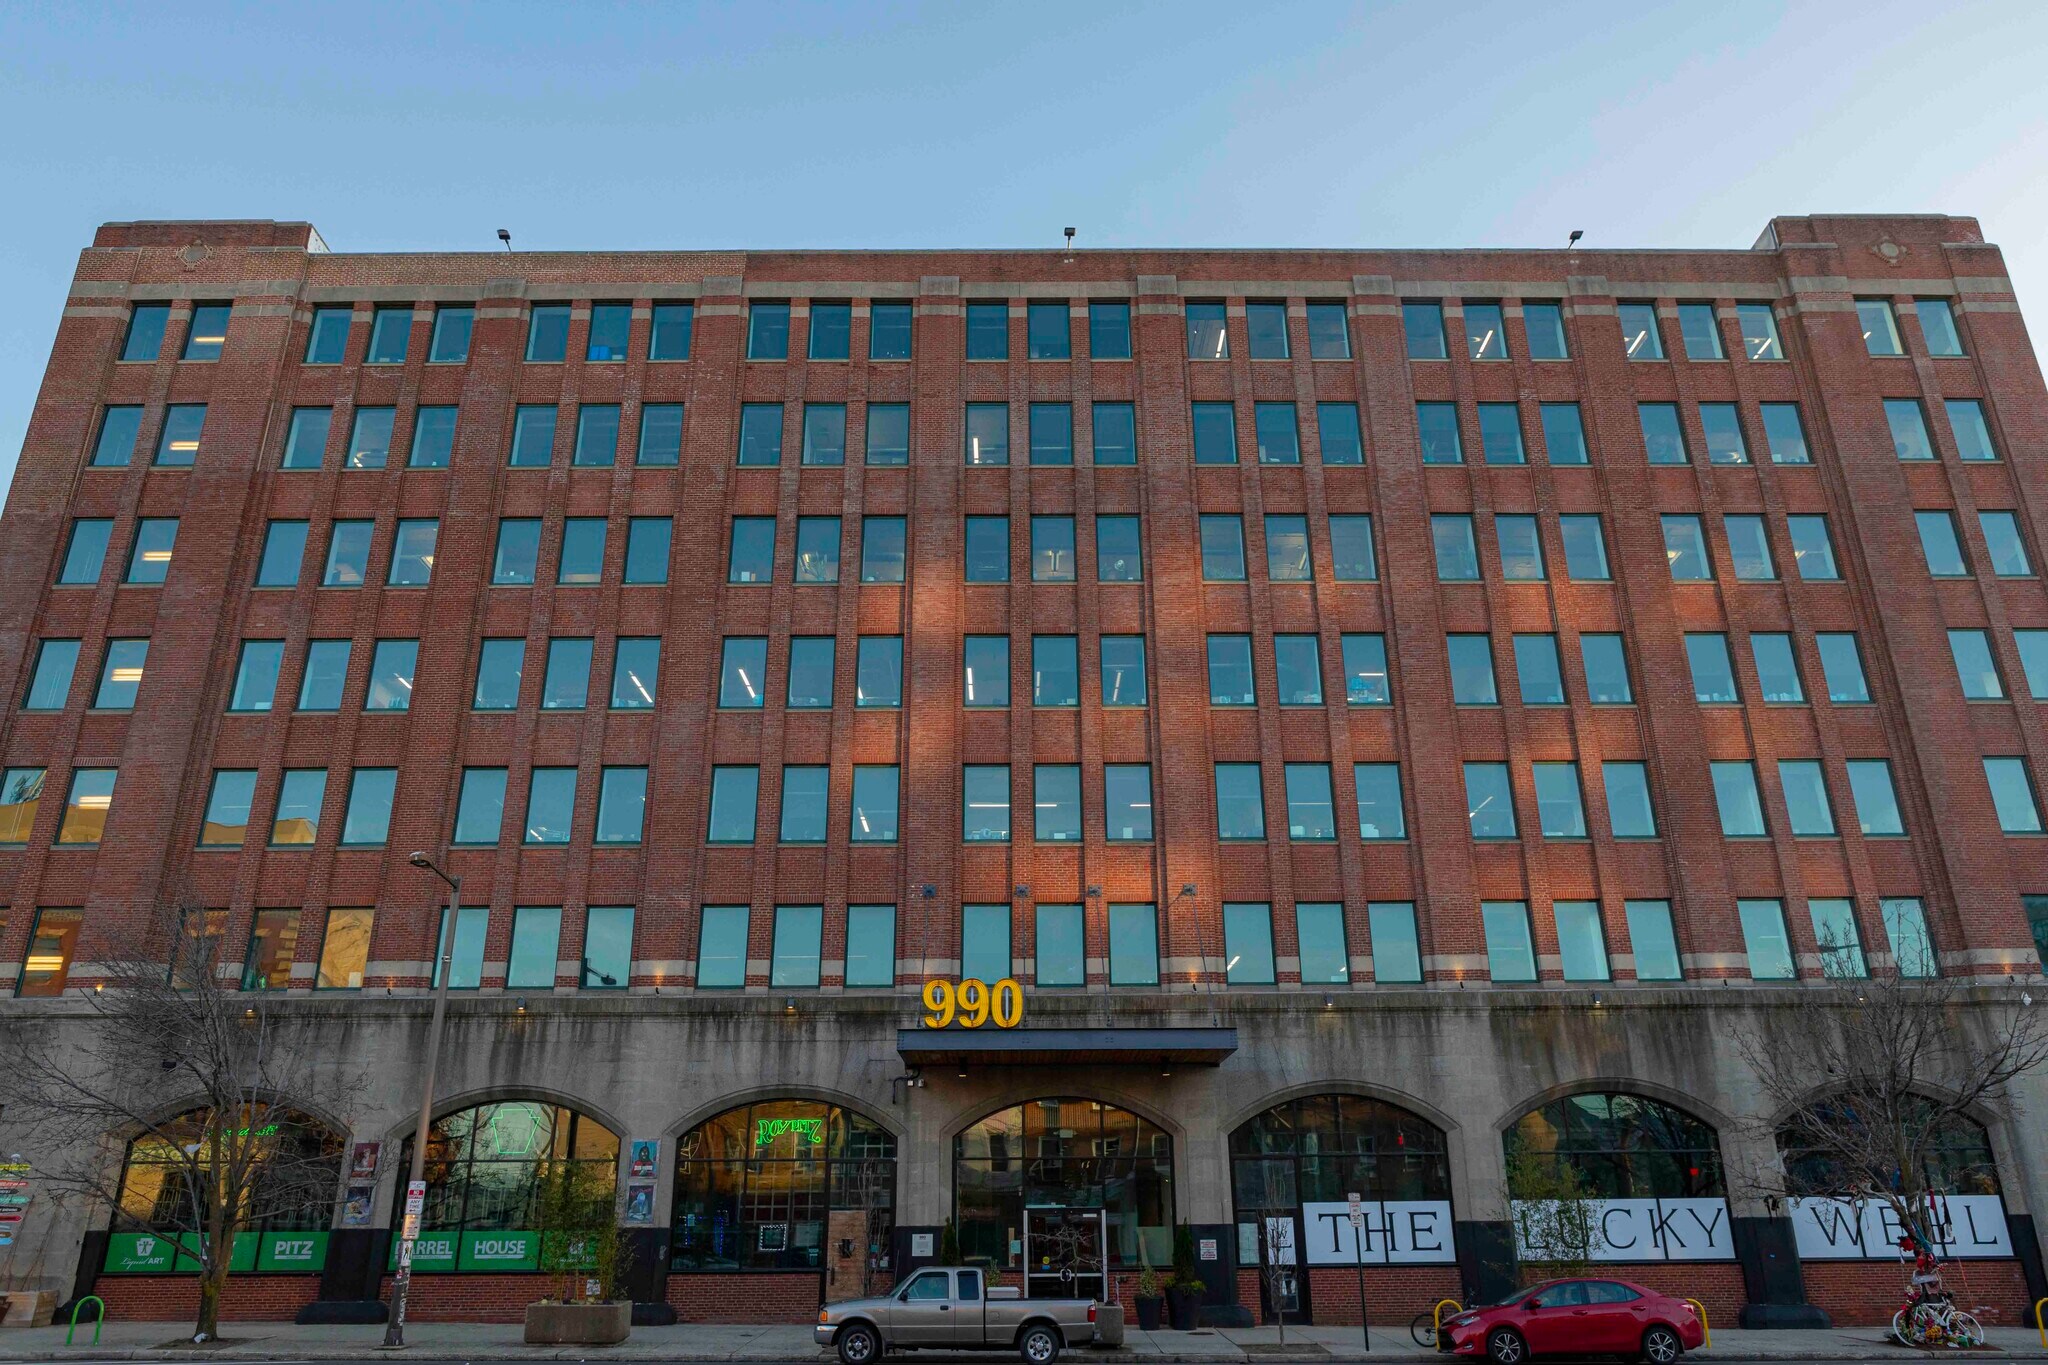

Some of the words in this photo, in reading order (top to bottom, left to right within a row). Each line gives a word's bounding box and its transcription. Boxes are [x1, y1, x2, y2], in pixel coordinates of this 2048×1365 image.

[923, 978, 1023, 1029] 990
[1318, 1211, 1442, 1253] THE
[1520, 1207, 1723, 1250] LUCKY
[274, 1240, 314, 1255] PITZ
[394, 1240, 452, 1254] RREL
[474, 1240, 526, 1254] HOUSE
